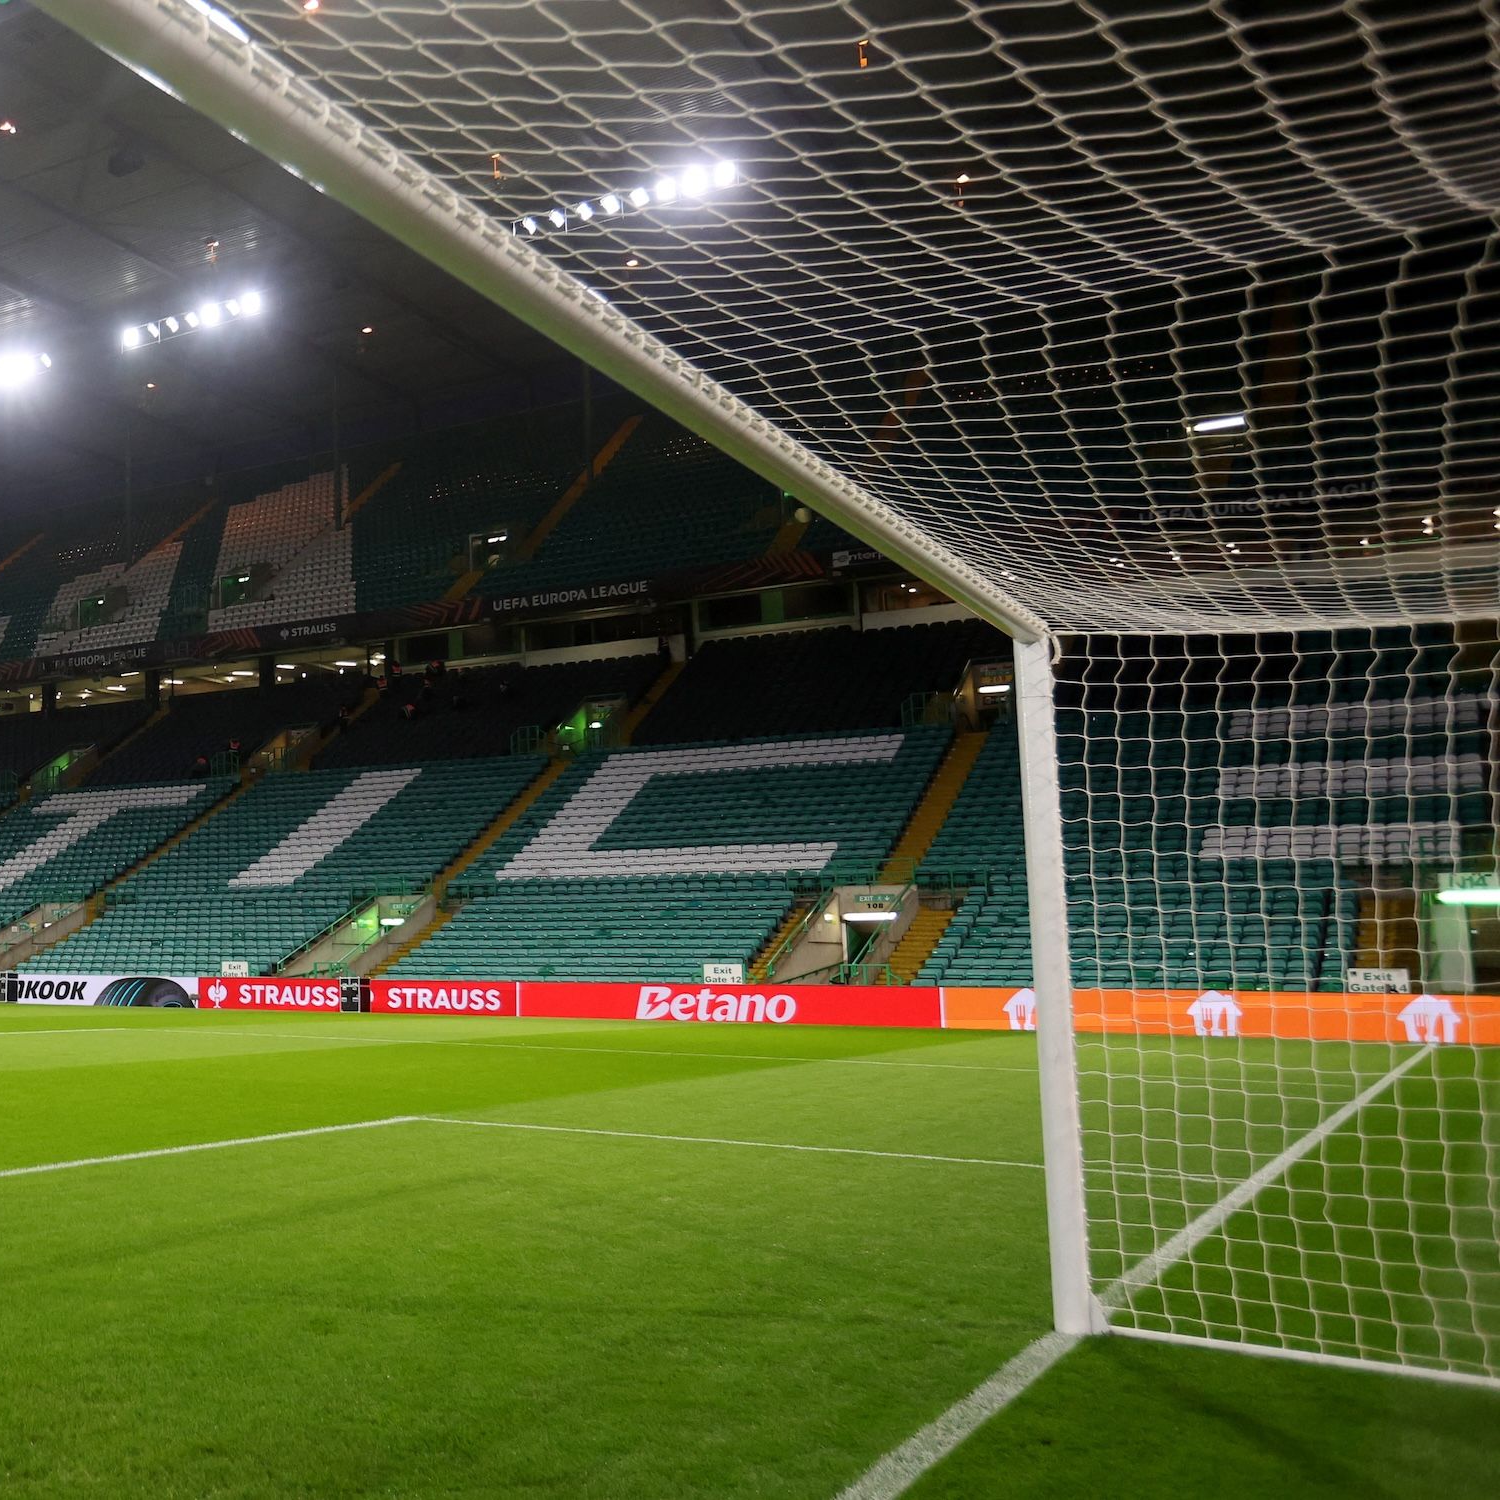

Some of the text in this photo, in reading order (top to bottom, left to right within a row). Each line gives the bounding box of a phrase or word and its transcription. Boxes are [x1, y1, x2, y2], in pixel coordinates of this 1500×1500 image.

[492, 580, 648, 611] UEFA EUROPA LEAGUE
[291, 623, 337, 637] STRAUSS
[68, 654, 105, 667] EUROPA
[713, 966, 732, 974] Exit
[1363, 972, 1393, 981] Exit
[1350, 983, 1385, 992] Gate
[239, 984, 340, 1006] STRAUSS
[388, 986, 501, 1011] STRAUSS
[635, 985, 797, 1023] Betano
